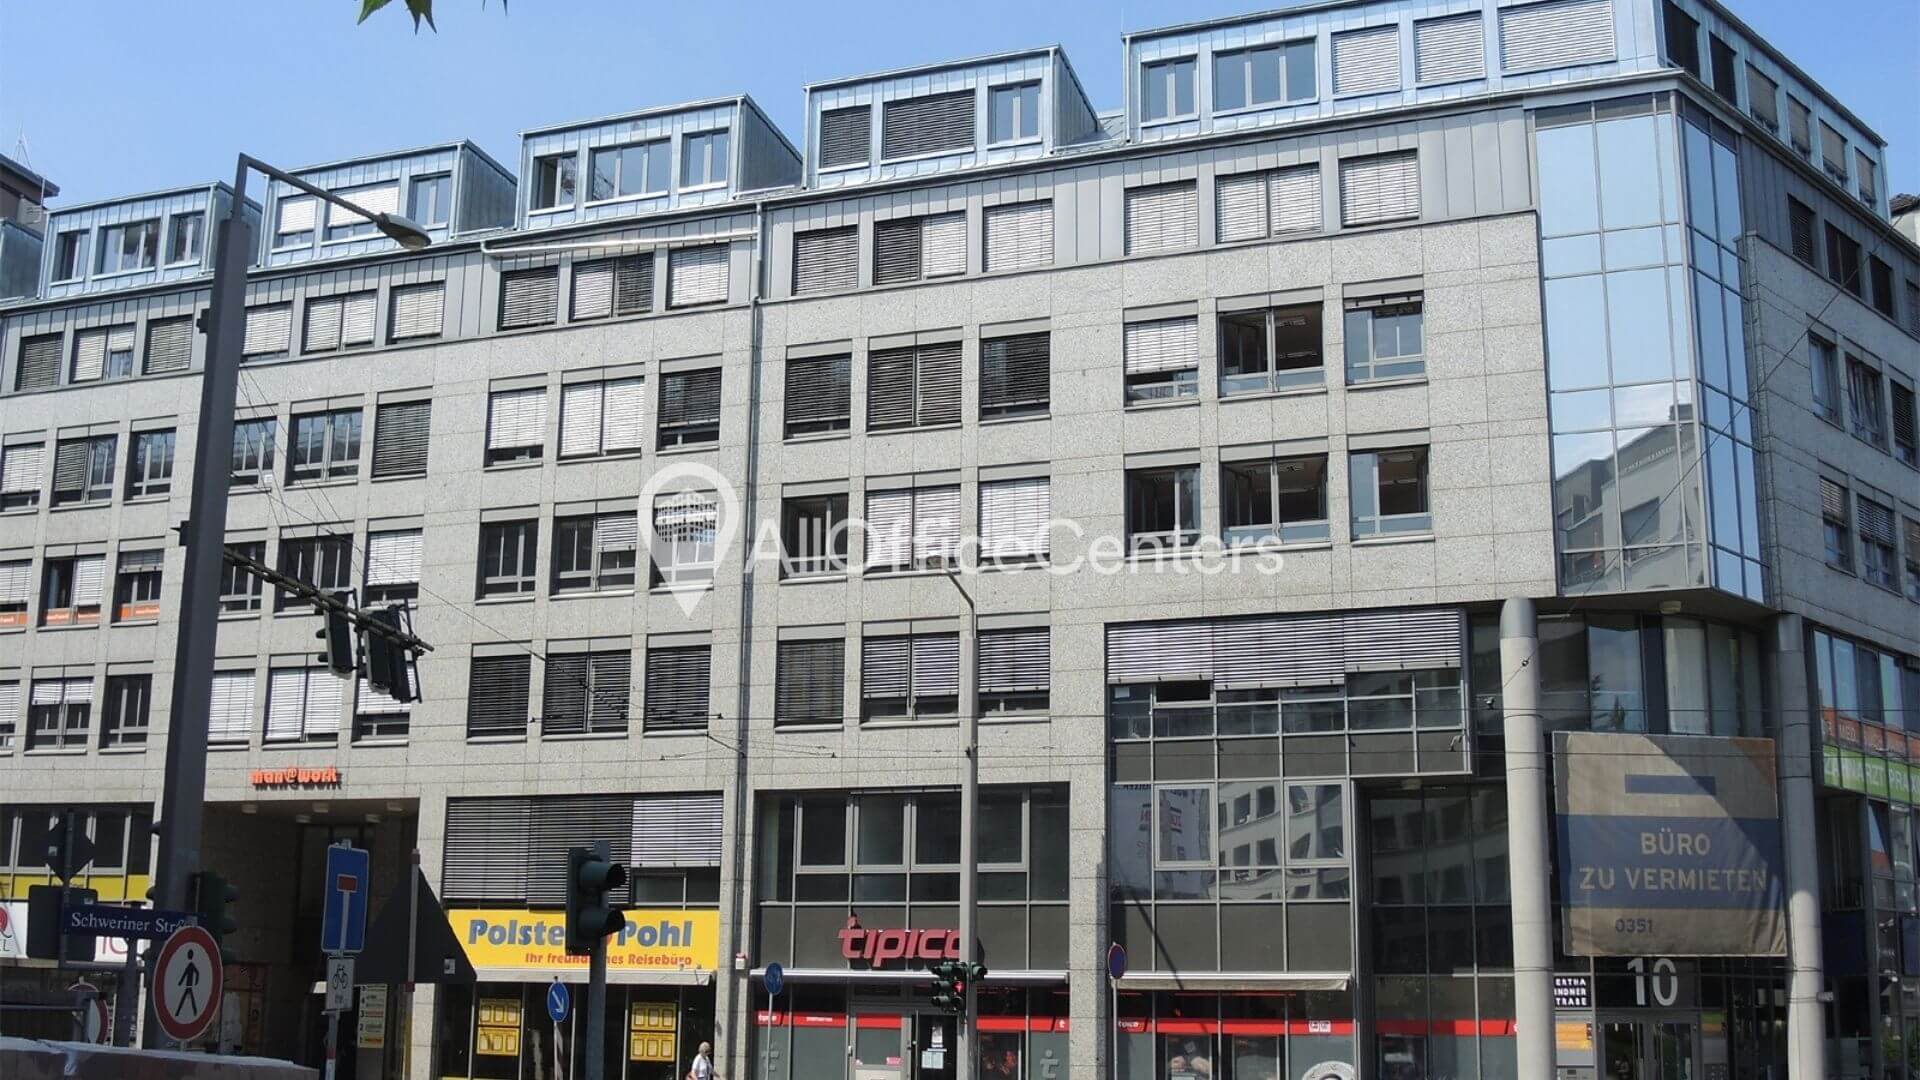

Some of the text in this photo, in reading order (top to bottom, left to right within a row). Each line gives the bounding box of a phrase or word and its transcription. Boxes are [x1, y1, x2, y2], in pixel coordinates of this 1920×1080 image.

[1641, 828, 1711, 855] BÜRO
[1579, 867, 1767, 892] ZU VERMIETEN
[71, 912, 150, 932] Schweriner
[1615, 919, 1654, 933] 0351
[468, 919, 692, 947] Polste Pohl
[526, 952, 543, 964] Ihr
[628, 952, 692, 966] Reisebüro
[1555, 978, 1587, 986] ERTHA
[1627, 957, 1678, 1006] 10
[1554, 988, 1587, 996] INDNER
